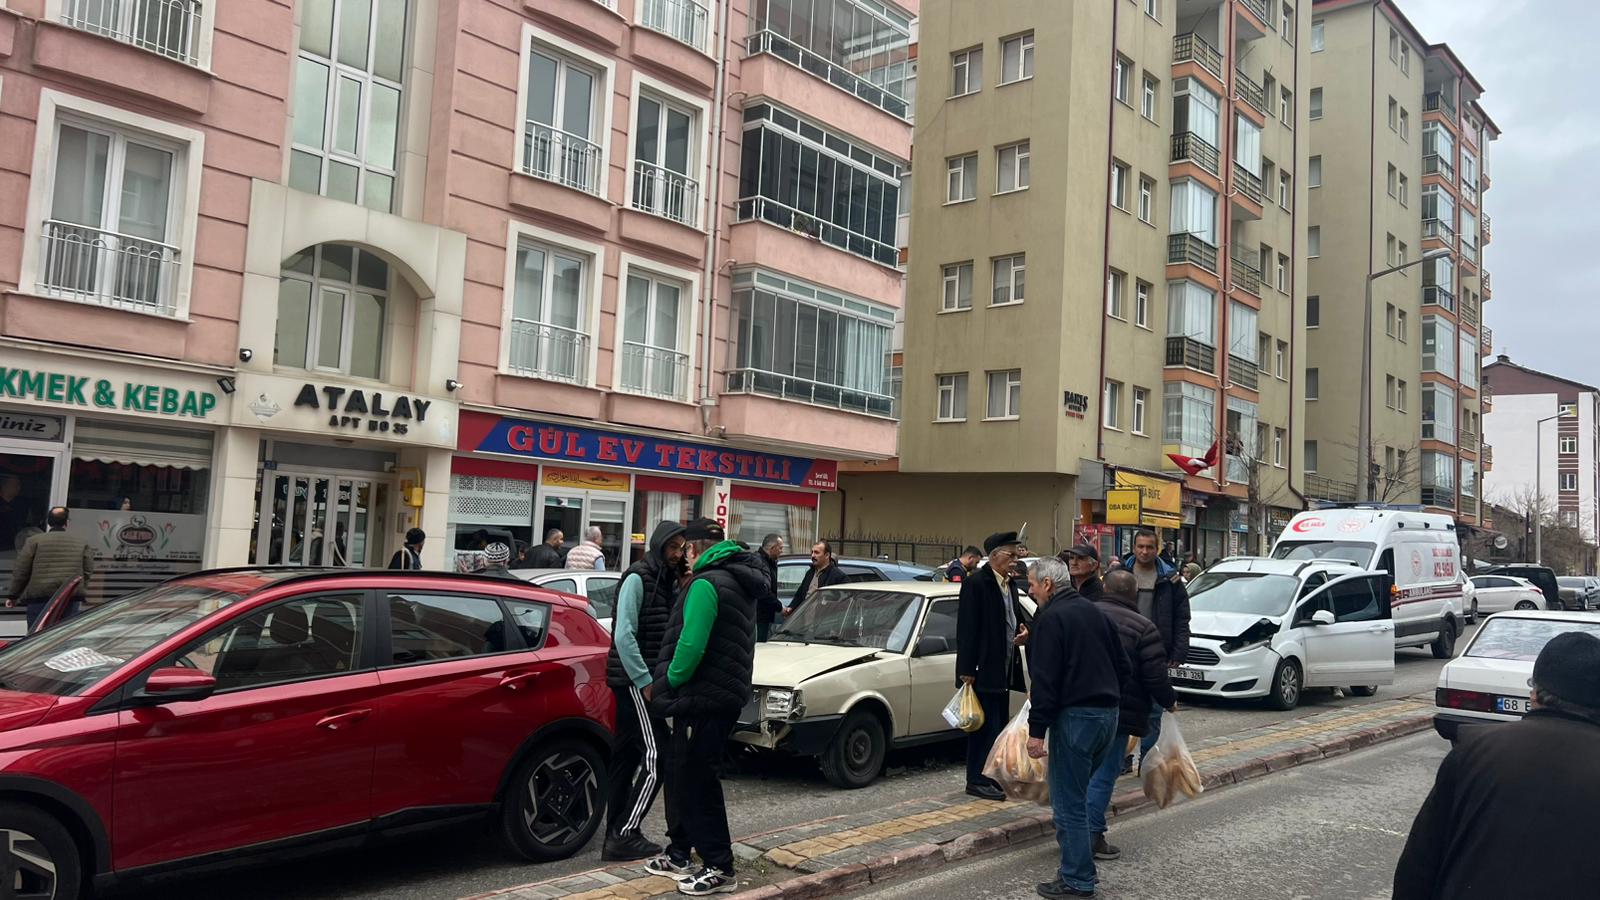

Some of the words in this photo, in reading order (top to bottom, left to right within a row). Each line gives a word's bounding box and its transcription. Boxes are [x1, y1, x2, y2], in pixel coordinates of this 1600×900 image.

[93, 379, 116, 409] &
[122, 382, 217, 419] KEBAP
[294, 383, 431, 422] ATALAY
[329, 415, 361, 429] APT
[368, 420, 389, 432] NO
[393, 422, 408, 435] 35
[507, 425, 586, 458] GÜL
[597, 436, 645, 463] EV
[655, 443, 792, 481] TEKSTİLİ
[1504, 699, 1518, 711] 68
